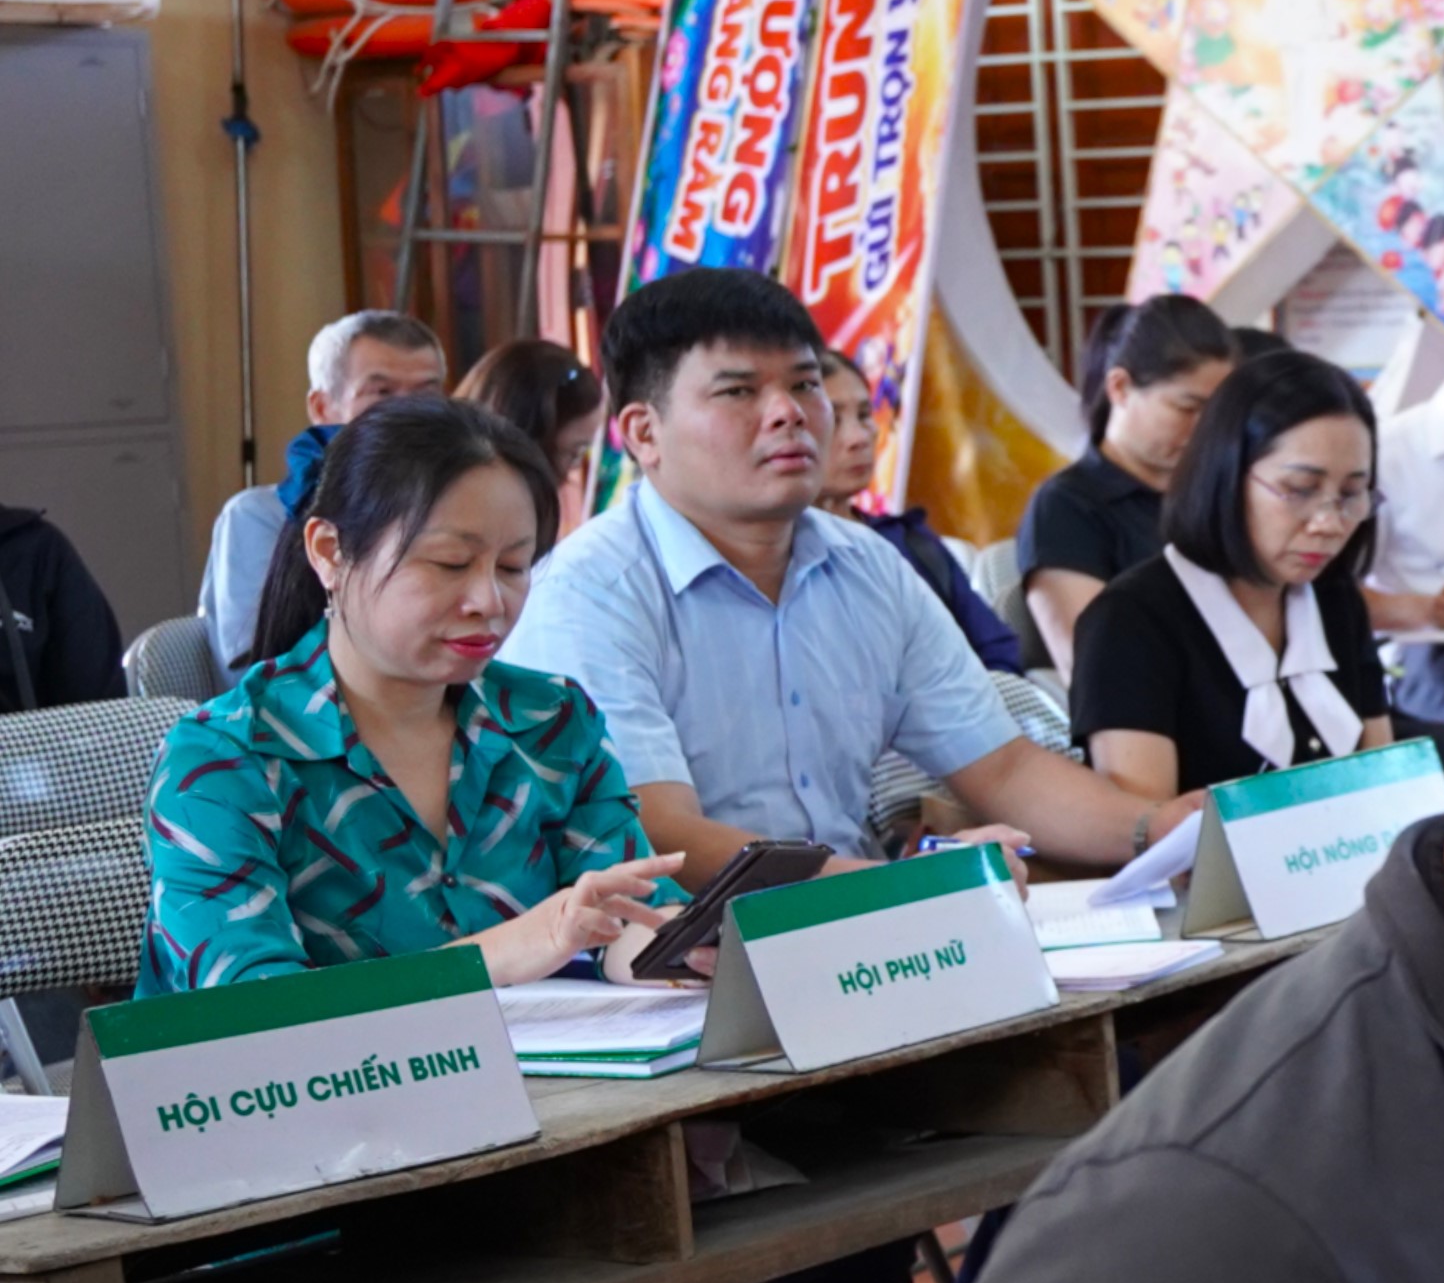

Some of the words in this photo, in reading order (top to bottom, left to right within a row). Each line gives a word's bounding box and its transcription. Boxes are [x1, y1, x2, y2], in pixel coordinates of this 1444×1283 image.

[872, 27, 912, 184] TRỌN
[857, 194, 894, 292] GỬI
[1284, 845, 1321, 876] HỘI
[1322, 835, 1378, 863] NÔNG
[837, 962, 883, 996] HỘI
[885, 952, 931, 982] PHỤ
[934, 939, 966, 970] NỮ
[157, 1092, 221, 1132] HỘI
[229, 1080, 298, 1119] CỰU
[306, 1054, 401, 1103] CHIẾN
[411, 1045, 481, 1083] BINH
